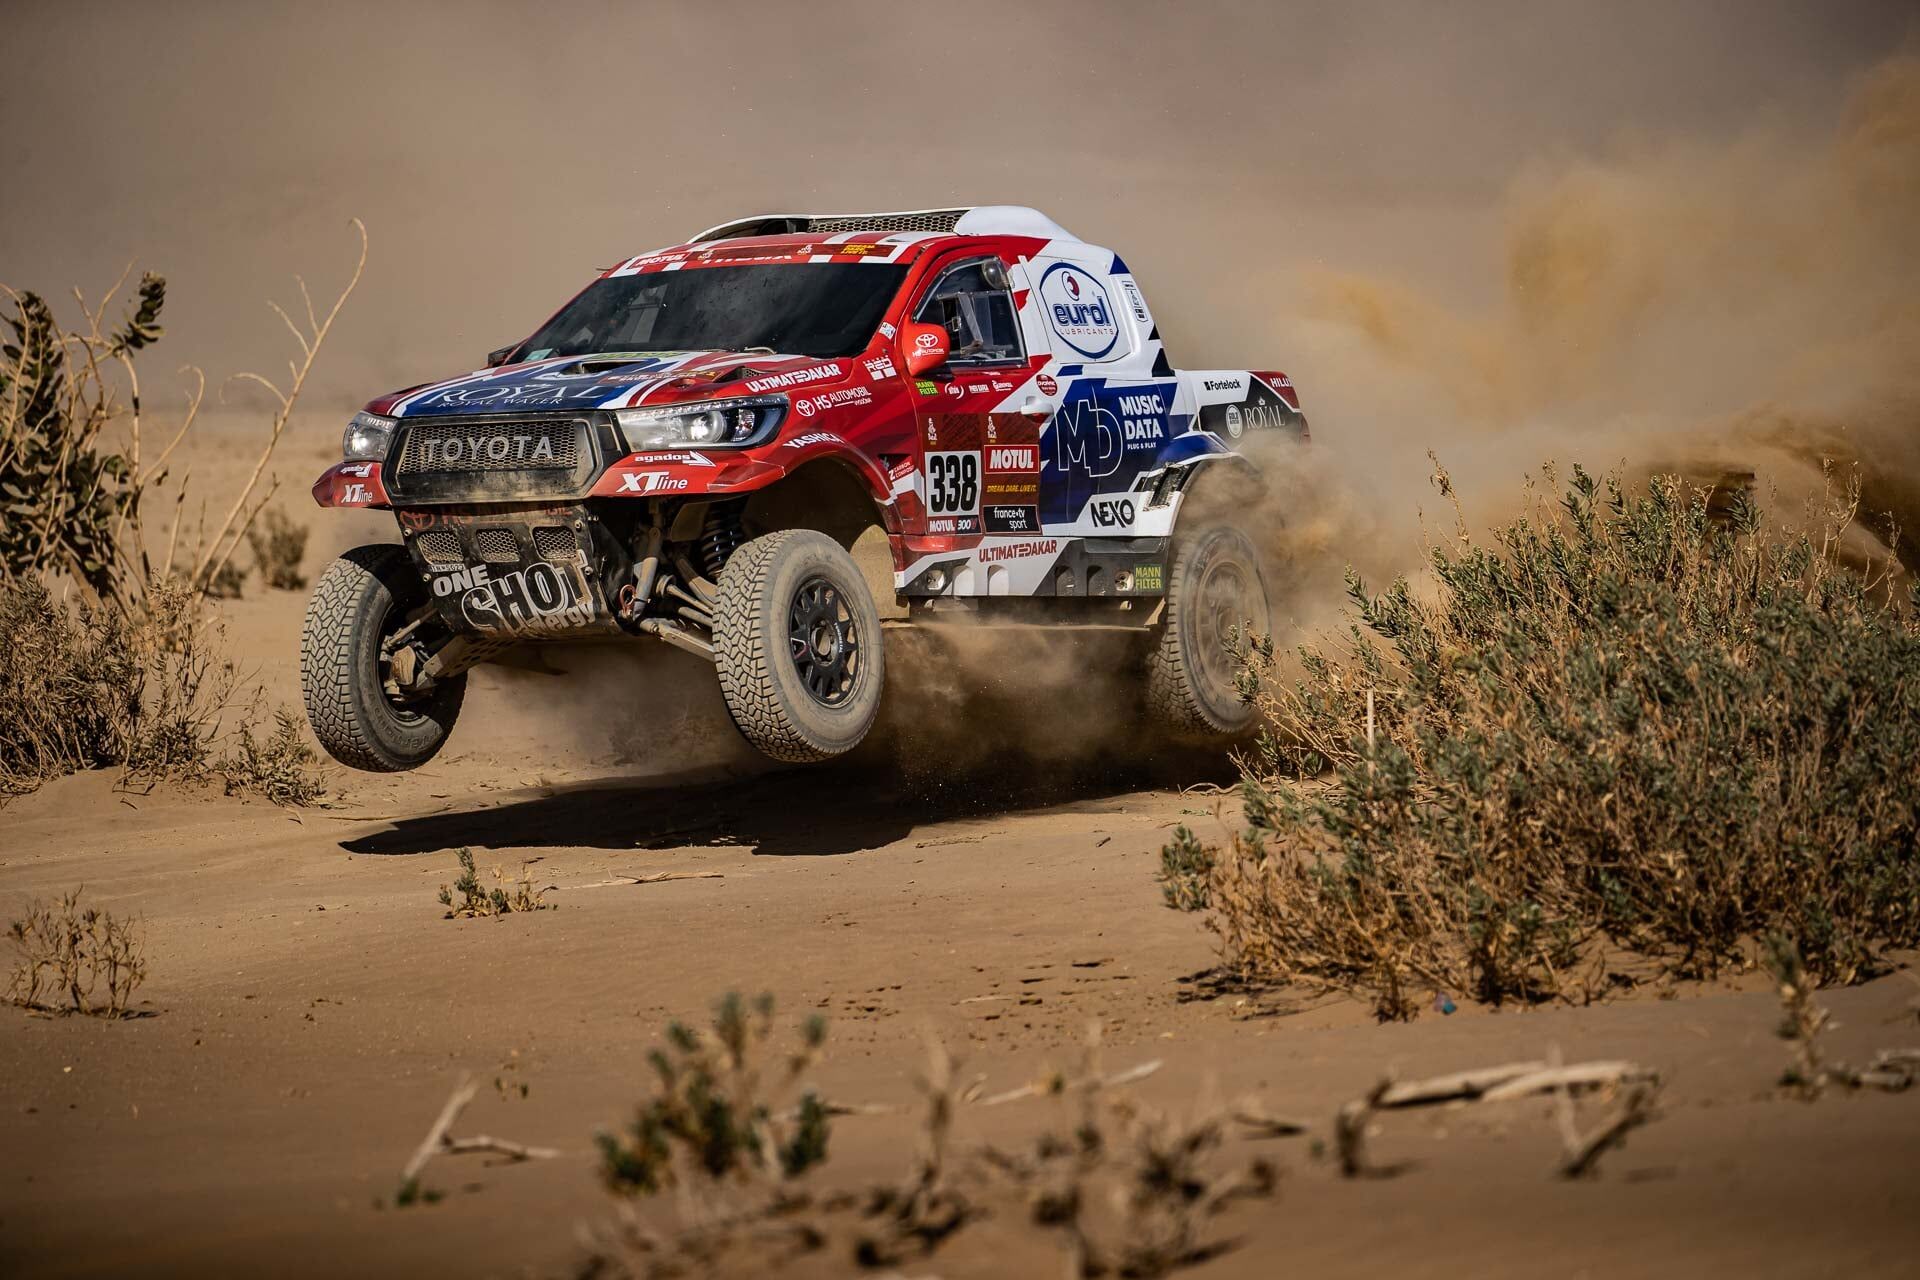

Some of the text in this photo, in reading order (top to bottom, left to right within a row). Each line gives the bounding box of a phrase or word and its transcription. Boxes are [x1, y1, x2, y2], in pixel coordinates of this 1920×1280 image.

[1053, 296, 1111, 326] eurol
[1210, 379, 1242, 390] Fortelock
[420, 386, 606, 405] ROYAL
[812, 386, 872, 411] HS AUTOMOBIL
[1118, 394, 1164, 416] MUSIC
[1244, 405, 1285, 429] ROYAL
[1124, 418, 1164, 440] DATA
[424, 435, 554, 463] TOYOTA
[783, 432, 845, 449] YASHICA
[635, 453, 691, 463] agados
[990, 449, 1034, 469] MOTUL
[616, 471, 688, 496] XTline
[930, 454, 978, 512] 338
[929, 519, 956, 533] MOTUL
[1009, 519, 1028, 532] sport
[432, 564, 490, 597] ONE
[1135, 566, 1161, 578] MANN
[1135, 578, 1162, 590] FILTER
